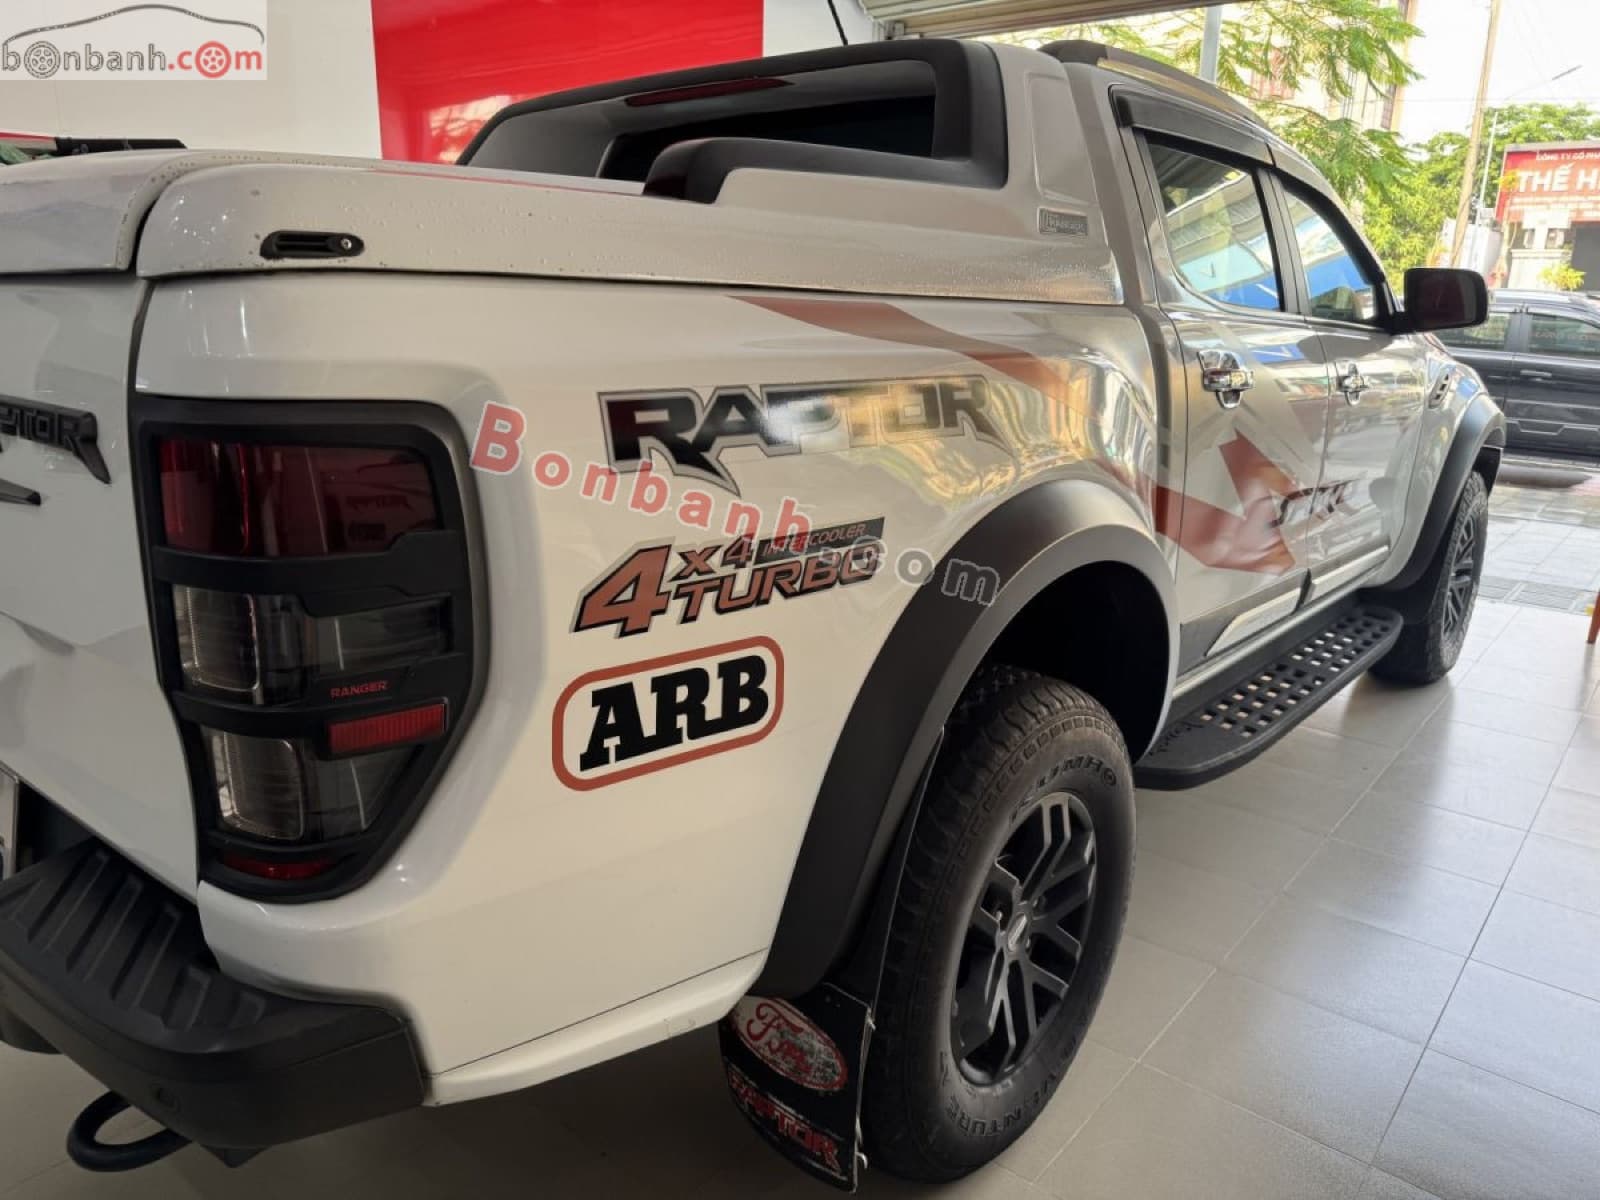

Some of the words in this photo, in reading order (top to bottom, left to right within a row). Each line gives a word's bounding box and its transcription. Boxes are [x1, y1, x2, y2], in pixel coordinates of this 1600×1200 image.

[1575, 167, 1600, 192] H
[672, 541, 884, 625] TURBO
[330, 680, 389, 698] RANGER
[579, 655, 769, 772] ARB
